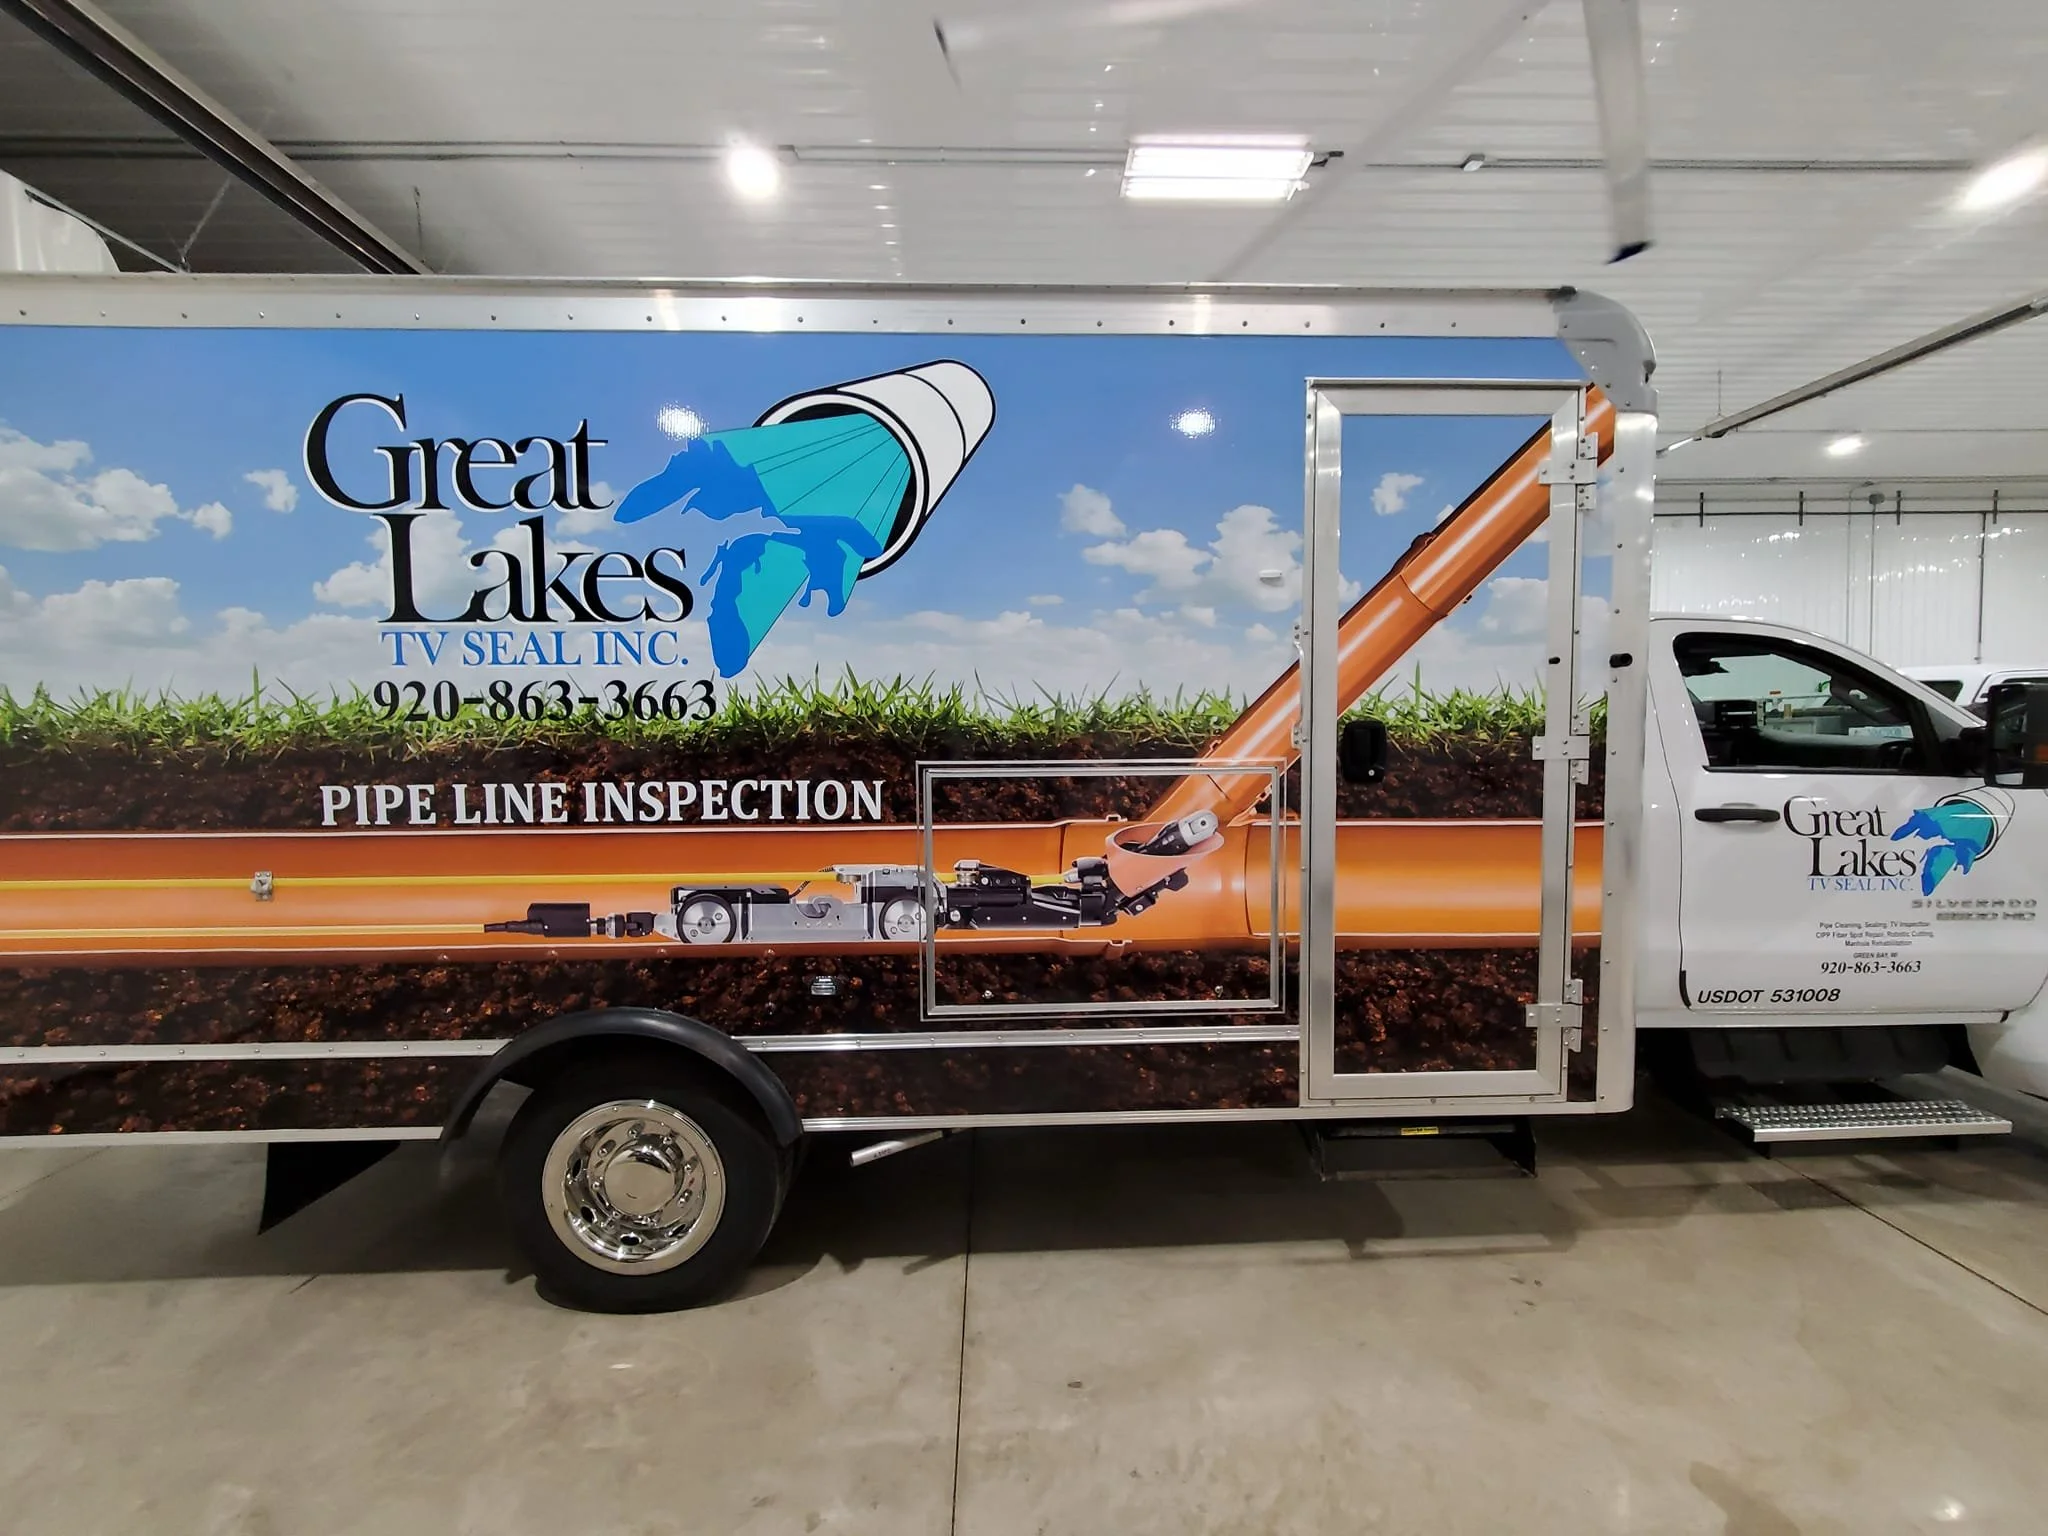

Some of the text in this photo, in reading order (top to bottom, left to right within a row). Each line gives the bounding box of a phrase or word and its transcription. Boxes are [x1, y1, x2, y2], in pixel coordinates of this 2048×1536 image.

[303, 393, 614, 514] Great
[374, 512, 695, 625] Lakes
[380, 630, 689, 666] TV SEAL INC.
[373, 678, 718, 723] 920-863-3663
[319, 779, 885, 827] PIPE LINE INSPECTION
[1783, 796, 1890, 837] Great
[1808, 837, 1917, 877] Lakes
[1808, 878, 1914, 891] TV SEAL INC.
[1820, 960, 1921, 974] 920-863-3663
[1697, 988, 1840, 1004] USDOT 531008
